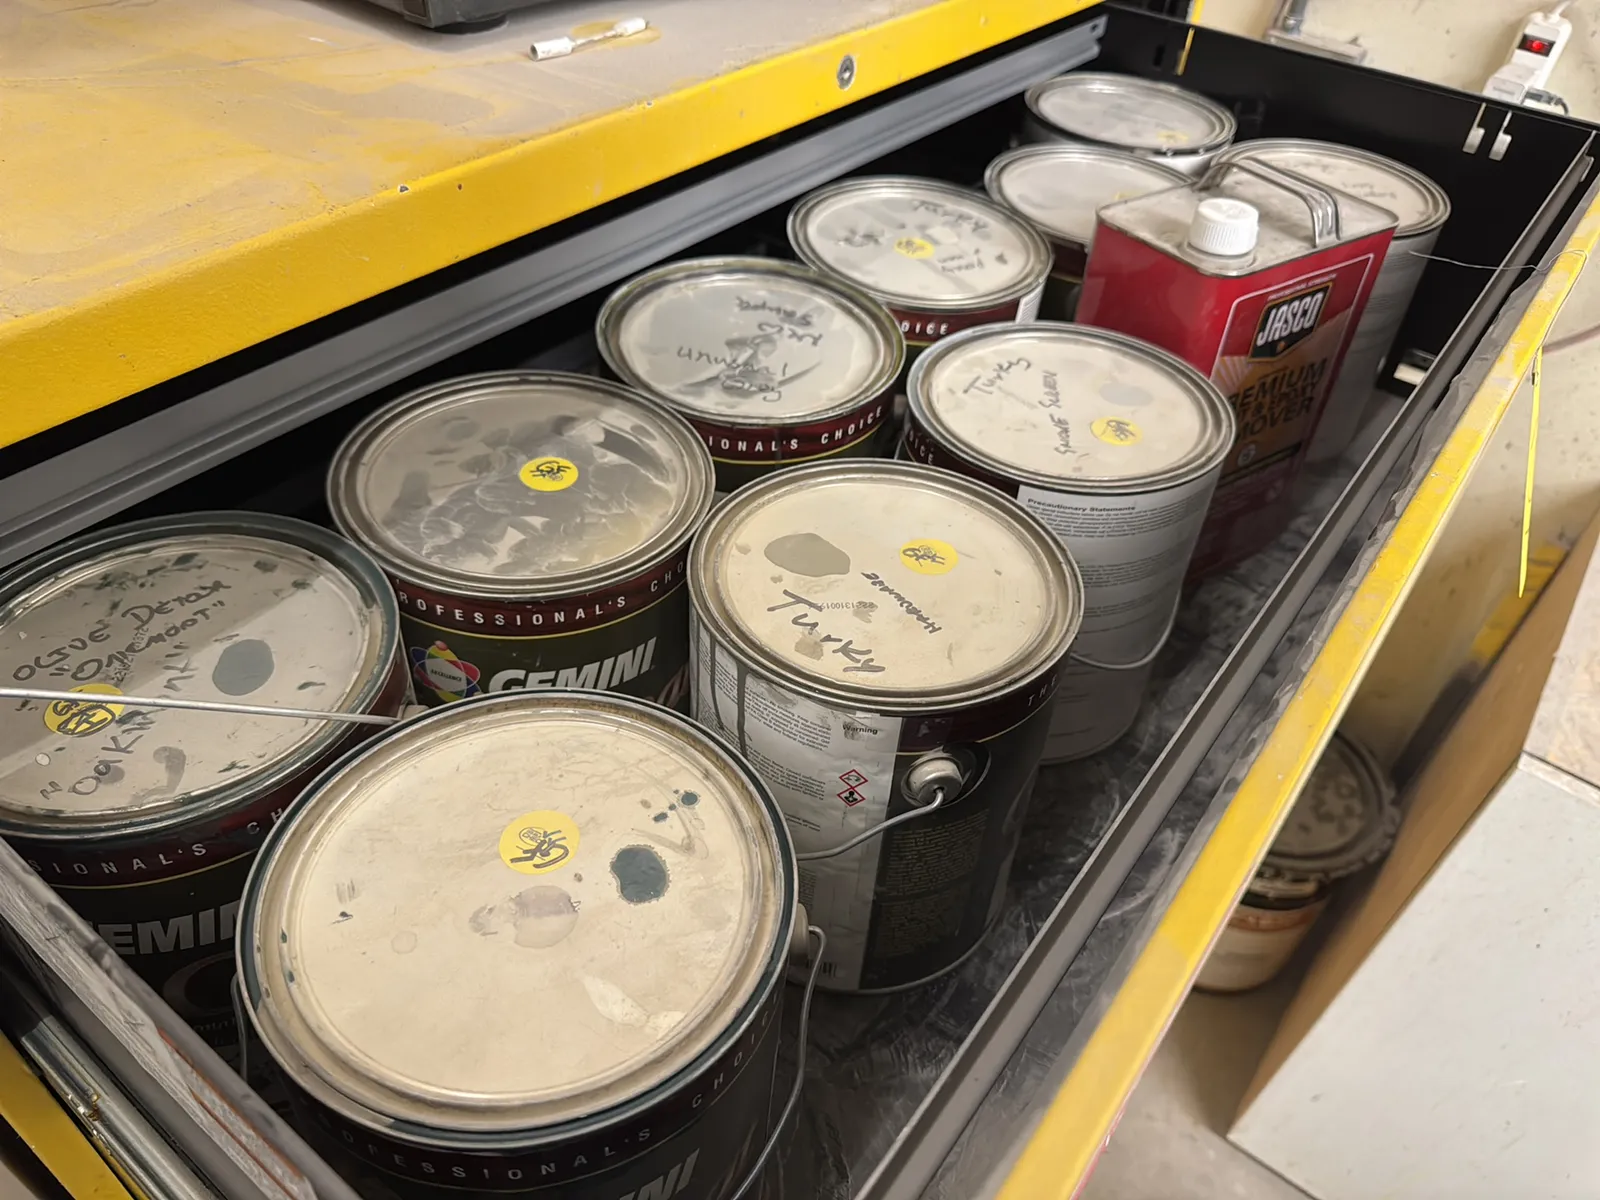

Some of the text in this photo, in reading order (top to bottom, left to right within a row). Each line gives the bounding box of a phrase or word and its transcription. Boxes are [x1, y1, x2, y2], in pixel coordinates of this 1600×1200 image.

[900, 321, 949, 335] OICE
[1256, 291, 1325, 346] JASCO
[1228, 357, 1327, 407] REMIUM
[708, 407, 883, 453] IONAL'S CHOICE
[908, 428, 934, 465] OICE
[1027, 498, 1088, 513] Precautionary
[399, 561, 685, 626] ROFESSIONAL'S CHO
[488, 636, 658, 693] GEMINI
[842, 723, 878, 736] Warning
[27, 842, 208, 876] SIONAL'S
[92, 898, 242, 956] EMIN
